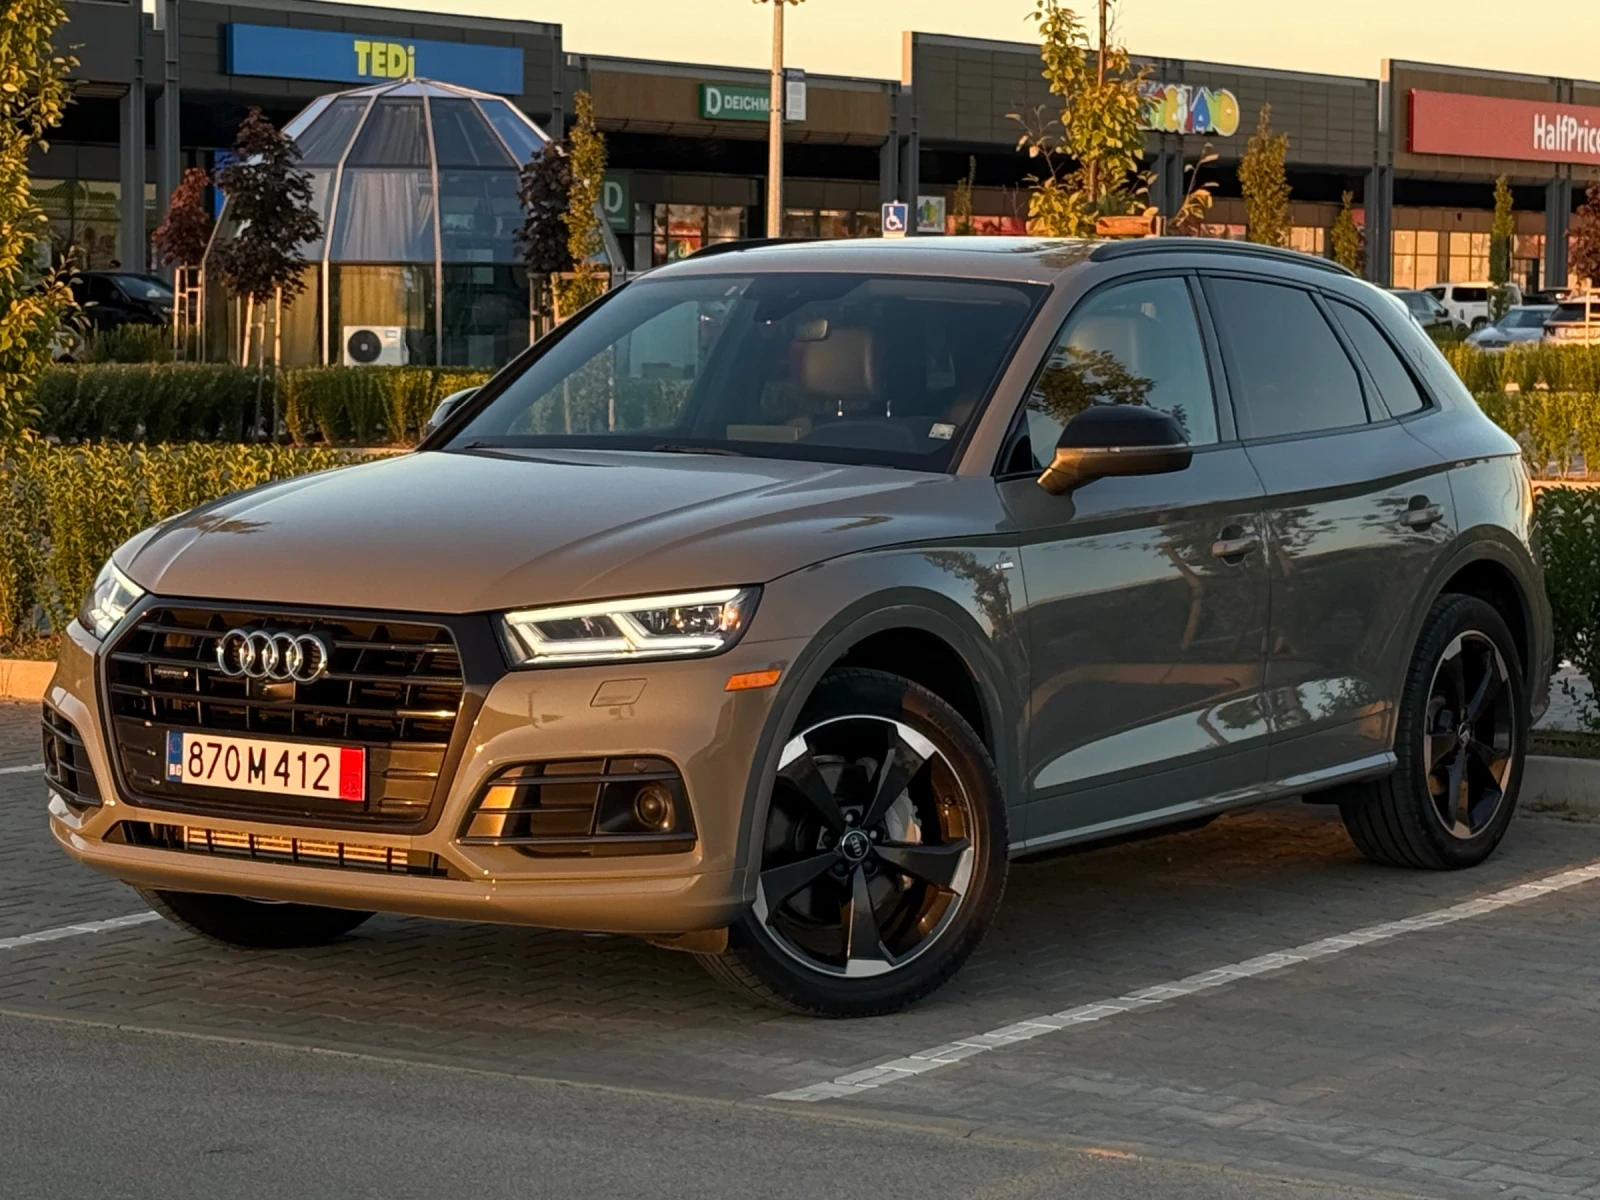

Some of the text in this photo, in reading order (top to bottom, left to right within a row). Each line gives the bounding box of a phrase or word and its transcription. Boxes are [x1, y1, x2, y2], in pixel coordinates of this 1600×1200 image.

[353, 40, 415, 79] TEDi
[724, 95, 770, 112] DEICHM
[169, 763, 182, 776] BG
